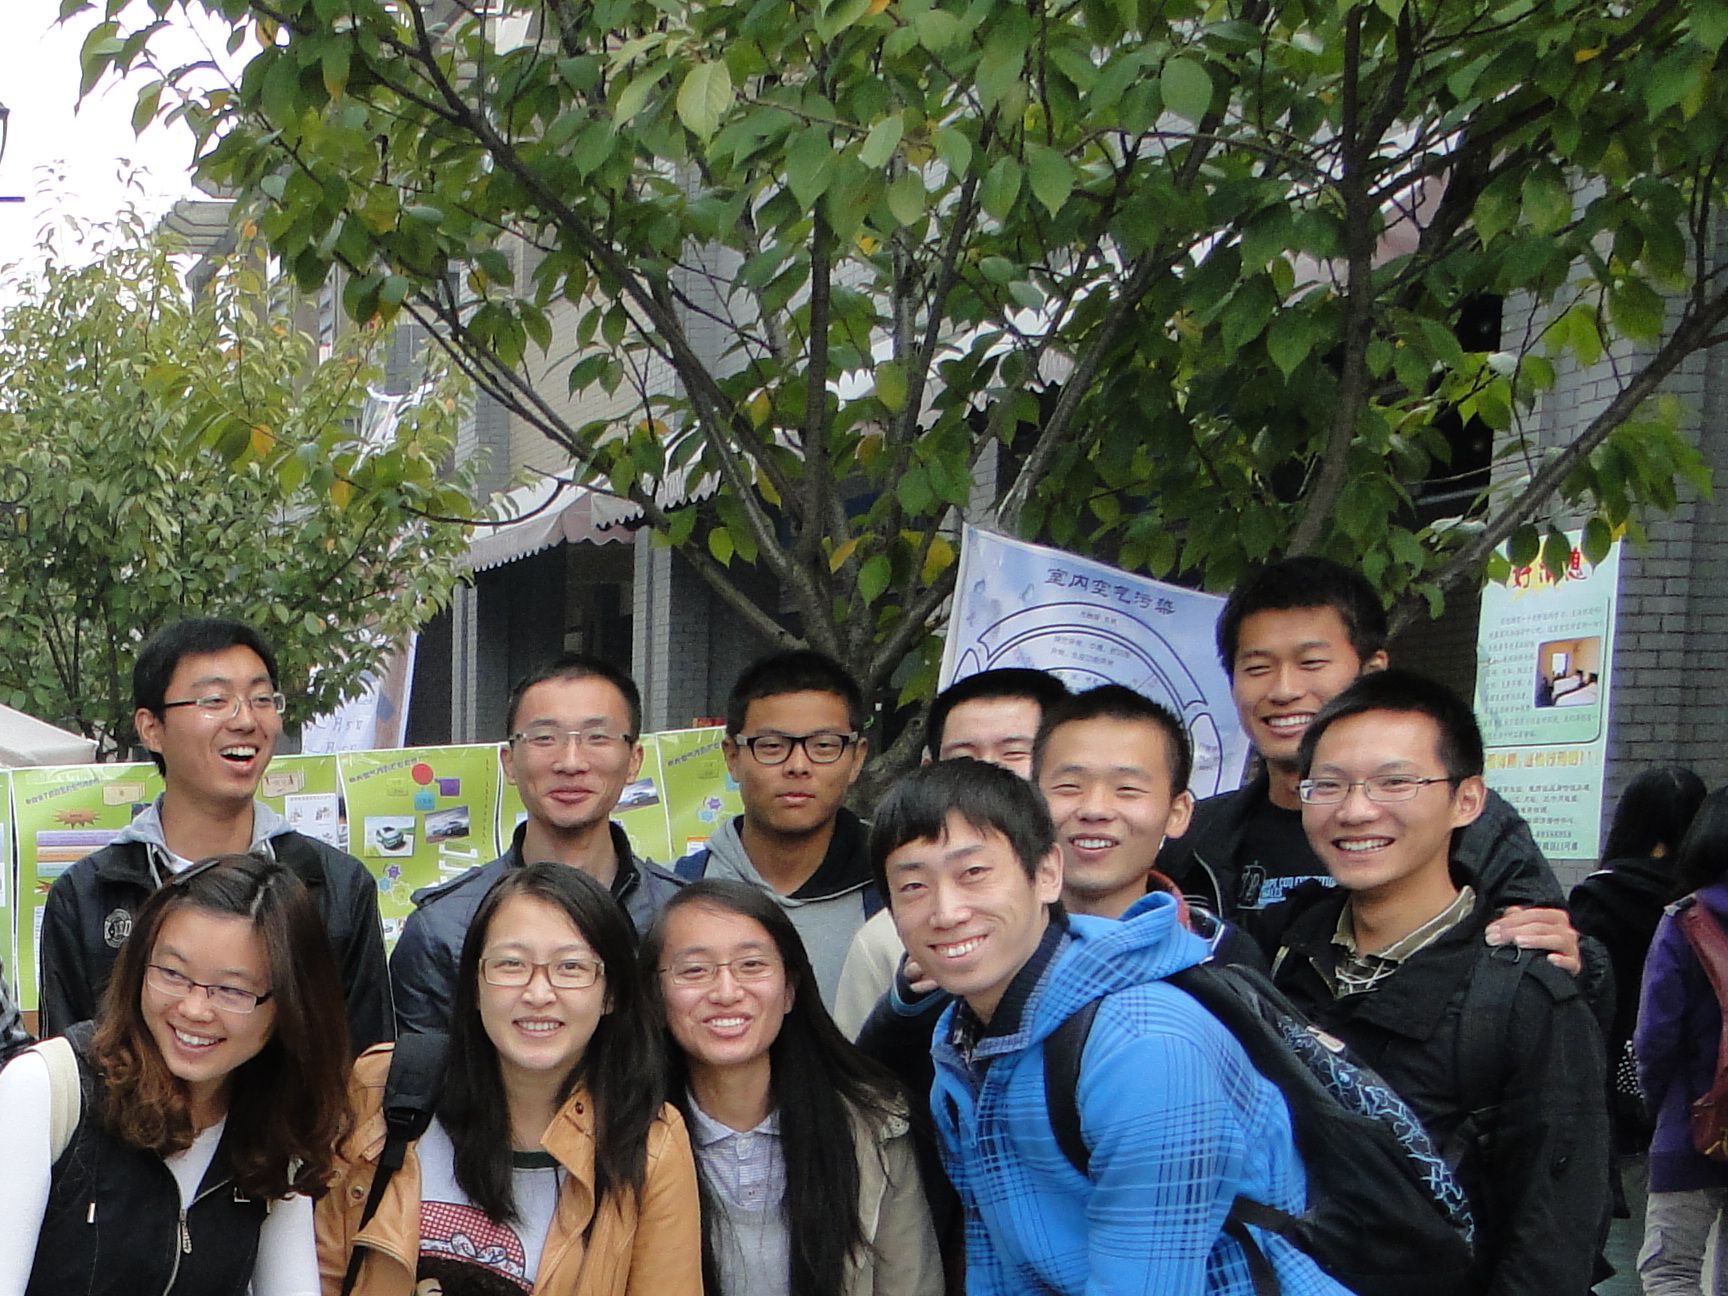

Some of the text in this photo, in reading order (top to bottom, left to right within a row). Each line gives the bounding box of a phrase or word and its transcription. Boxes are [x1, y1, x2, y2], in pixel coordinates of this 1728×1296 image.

[1045, 567, 1177, 616] 室内空气污染
